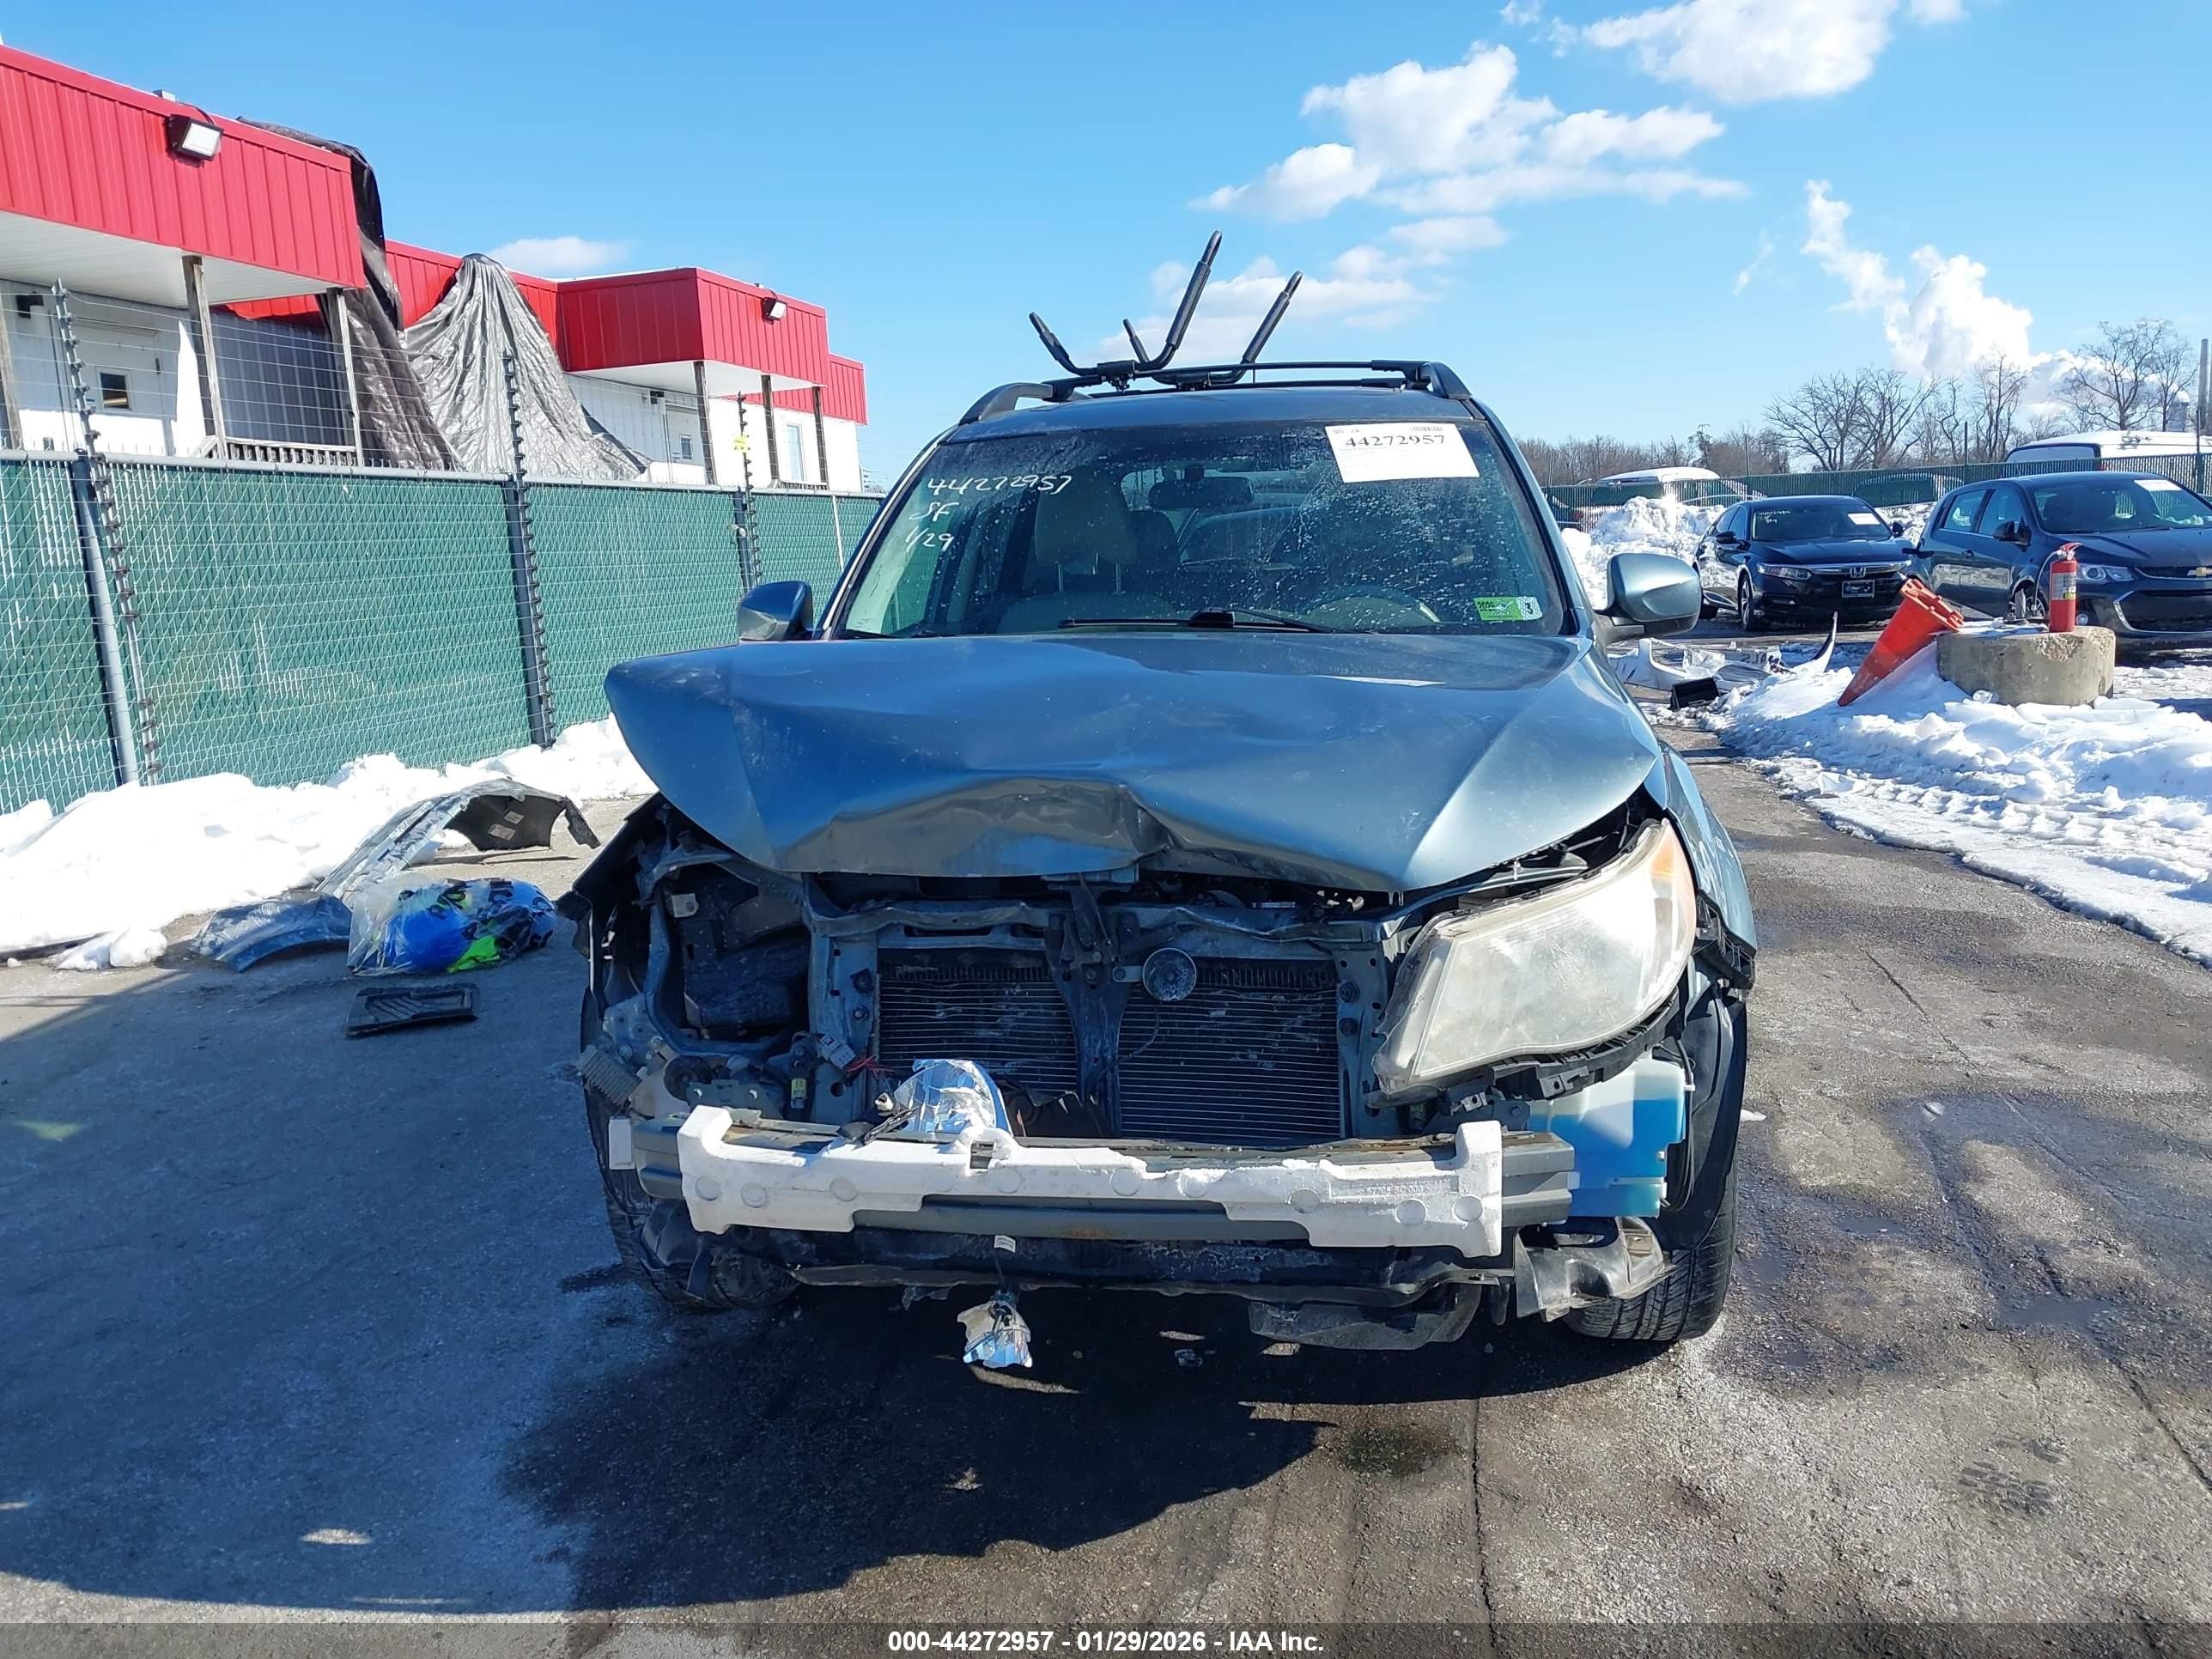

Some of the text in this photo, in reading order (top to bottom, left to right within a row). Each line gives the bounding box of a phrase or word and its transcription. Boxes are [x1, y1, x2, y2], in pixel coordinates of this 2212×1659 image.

[1345, 434, 1445, 447] 44272957
[927, 475, 1073, 496] 44272957
[1524, 602, 1534, 615] 3
